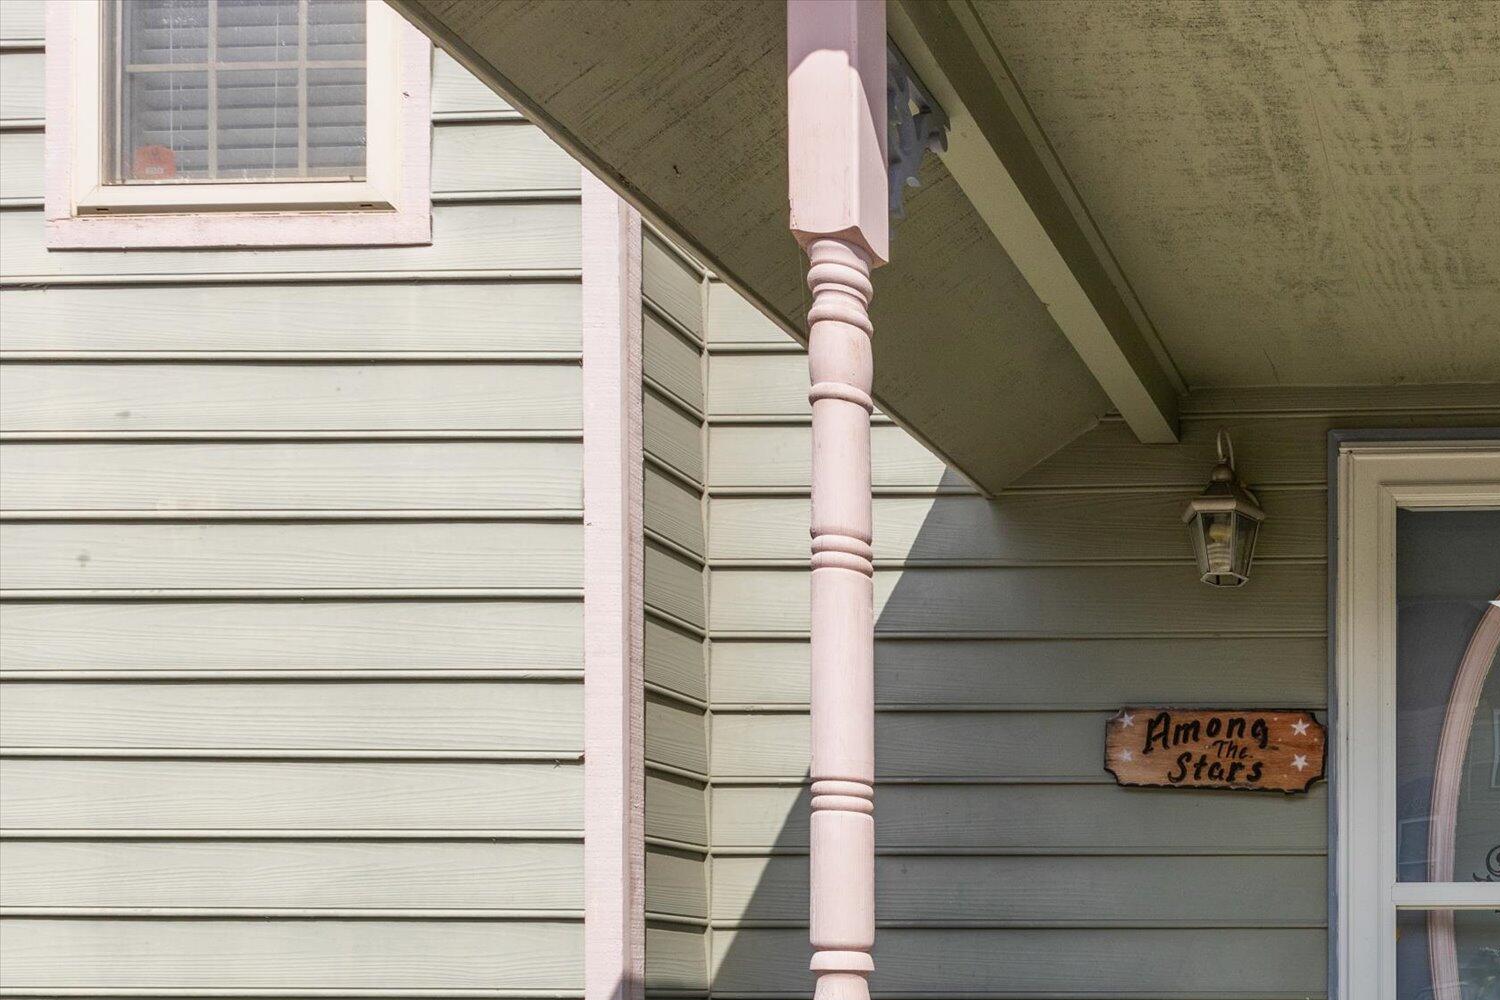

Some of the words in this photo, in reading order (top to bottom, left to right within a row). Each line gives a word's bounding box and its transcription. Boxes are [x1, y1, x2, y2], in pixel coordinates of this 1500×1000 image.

[1142, 711, 1269, 754] Among
[1212, 739, 1250, 760] The
[1167, 751, 1265, 784] Stars
